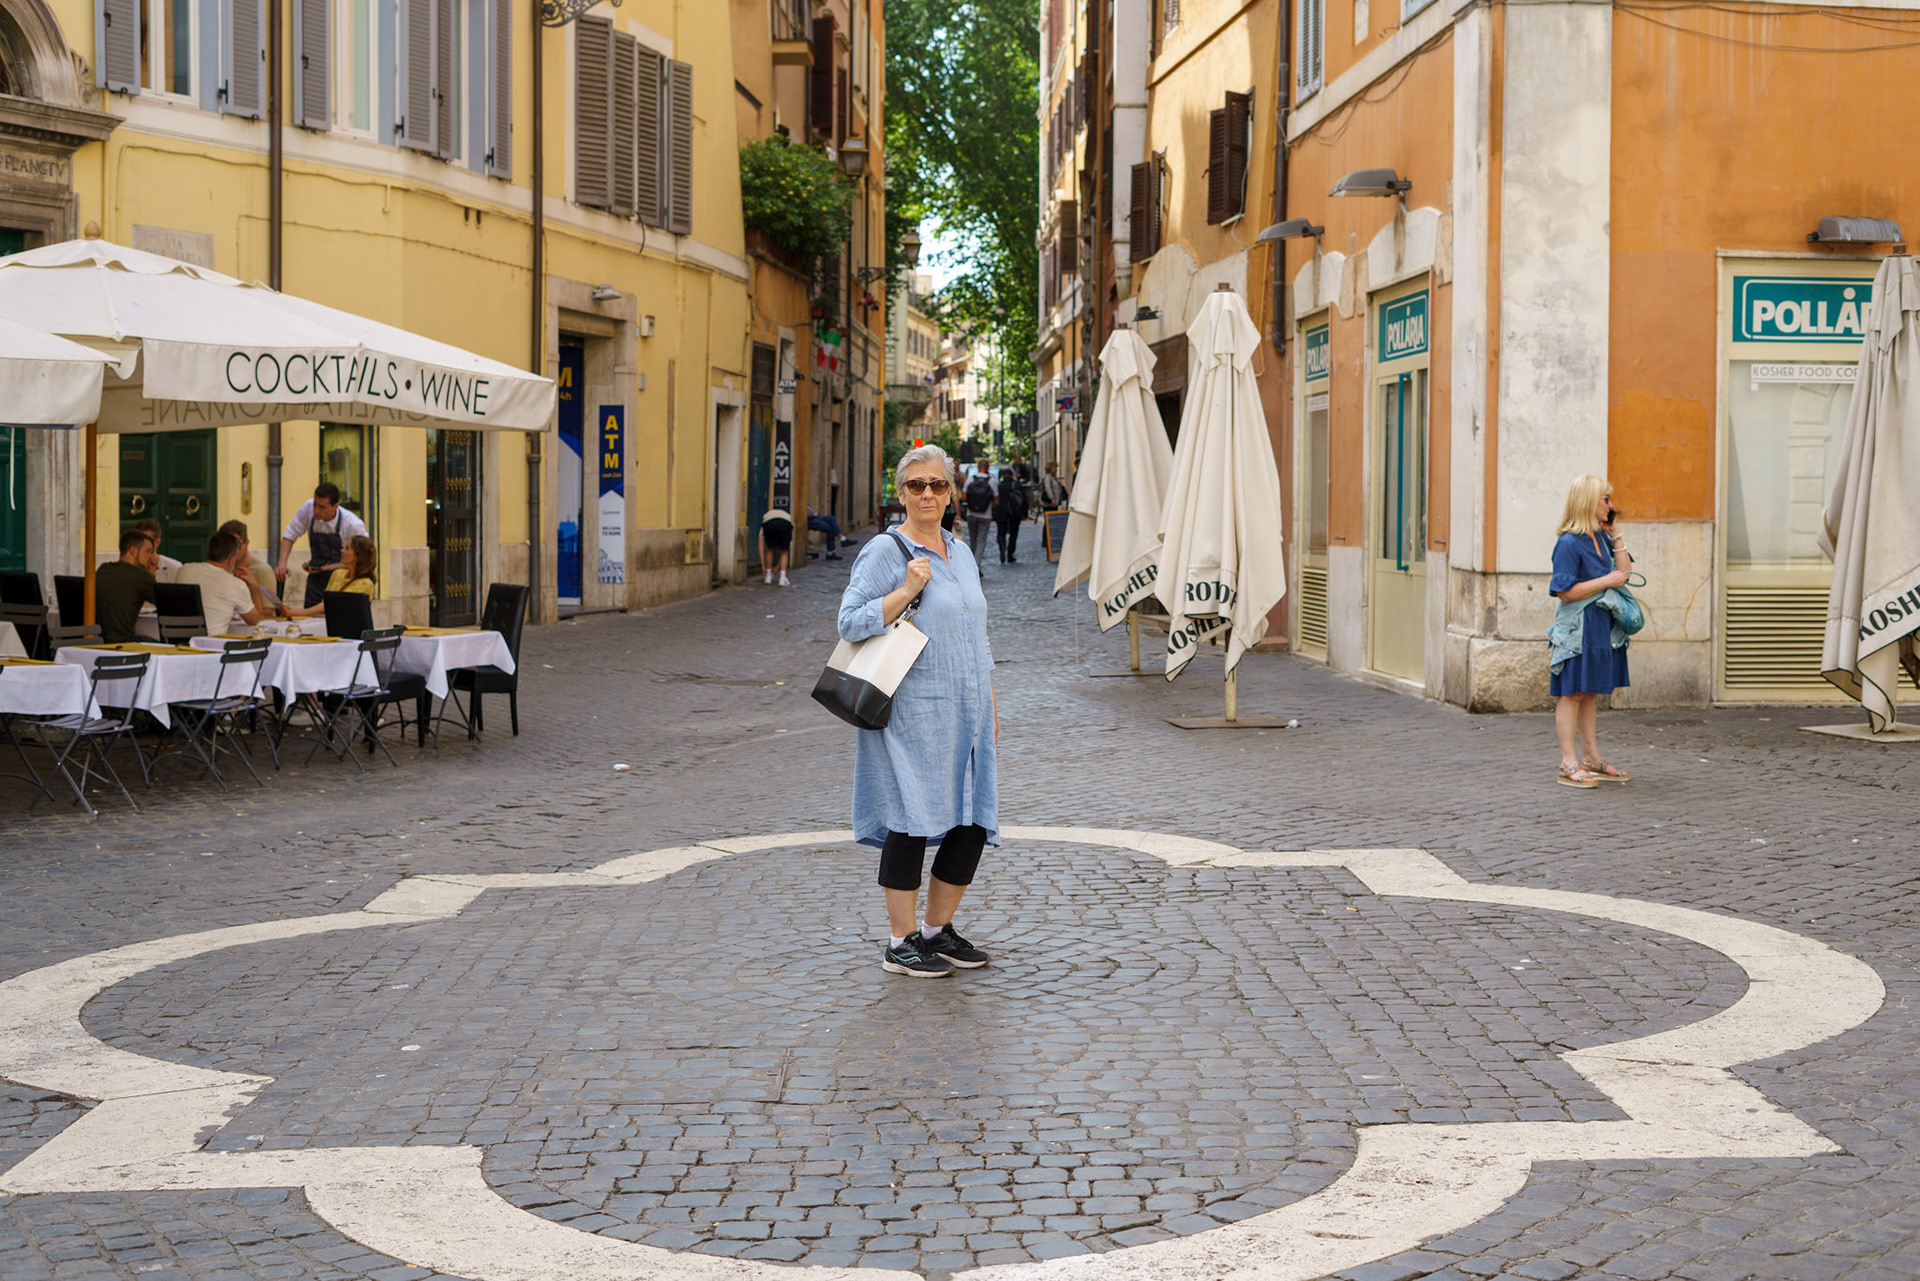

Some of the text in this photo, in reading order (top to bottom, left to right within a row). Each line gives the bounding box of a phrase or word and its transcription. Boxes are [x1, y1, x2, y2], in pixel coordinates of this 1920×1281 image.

[226, 352, 490, 416] COCKTAILS WINE
[1753, 366, 1794, 378] KOSHER
[1799, 367, 1832, 378] FOOD
[605, 415, 619, 469] ATM
[775, 441, 789, 479] ATM
